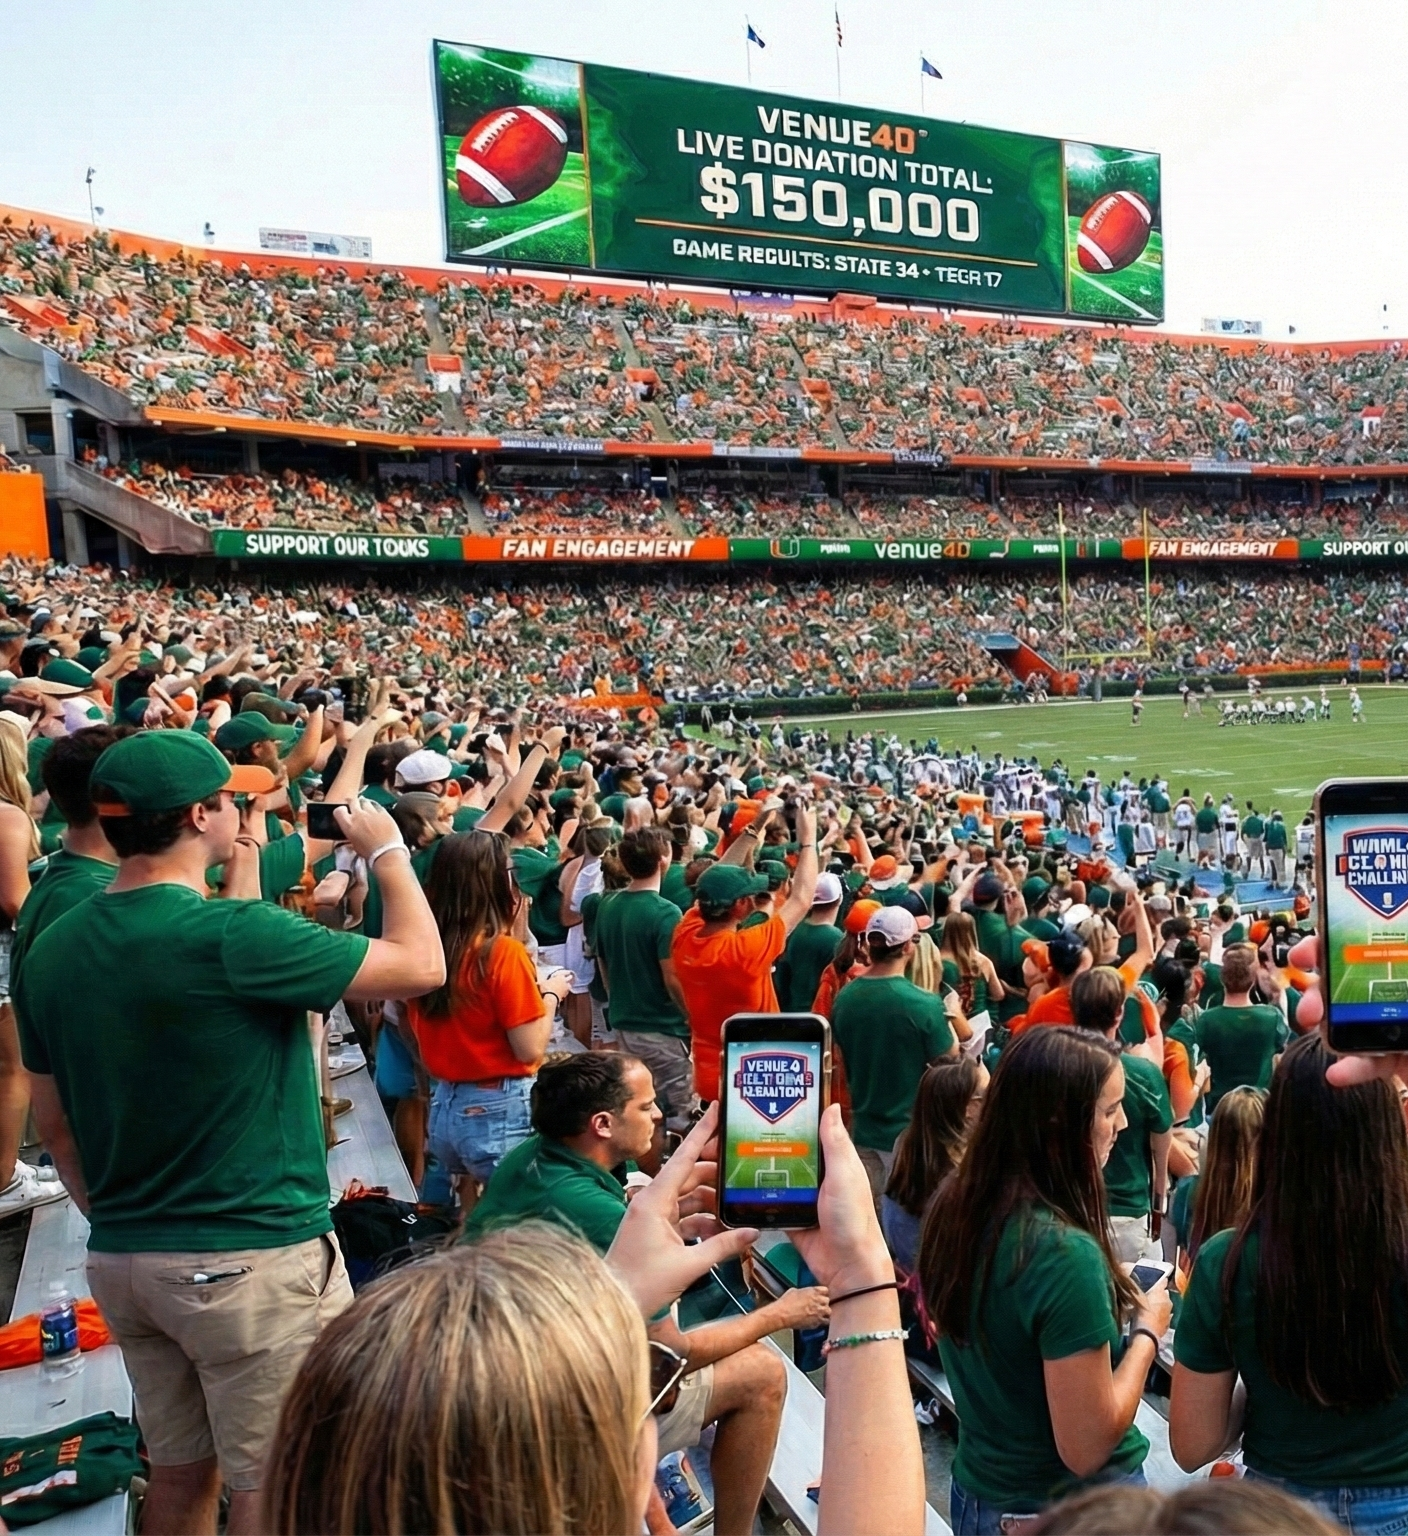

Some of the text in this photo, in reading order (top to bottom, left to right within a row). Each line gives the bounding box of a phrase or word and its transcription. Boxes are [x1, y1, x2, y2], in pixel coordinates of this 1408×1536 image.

[677, 128, 745, 160] LIVE
[752, 138, 897, 181] DONATION
[700, 161, 980, 242] $150,000
[834, 255, 892, 276] STATE
[896, 262, 919, 278] 34
[984, 271, 1003, 288] 17
[246, 534, 329, 556] SUPPORT
[334, 537, 370, 556] OUR
[502, 540, 696, 558] FAN ENGAGEMENT
[1323, 541, 1389, 556] SUPPORT
